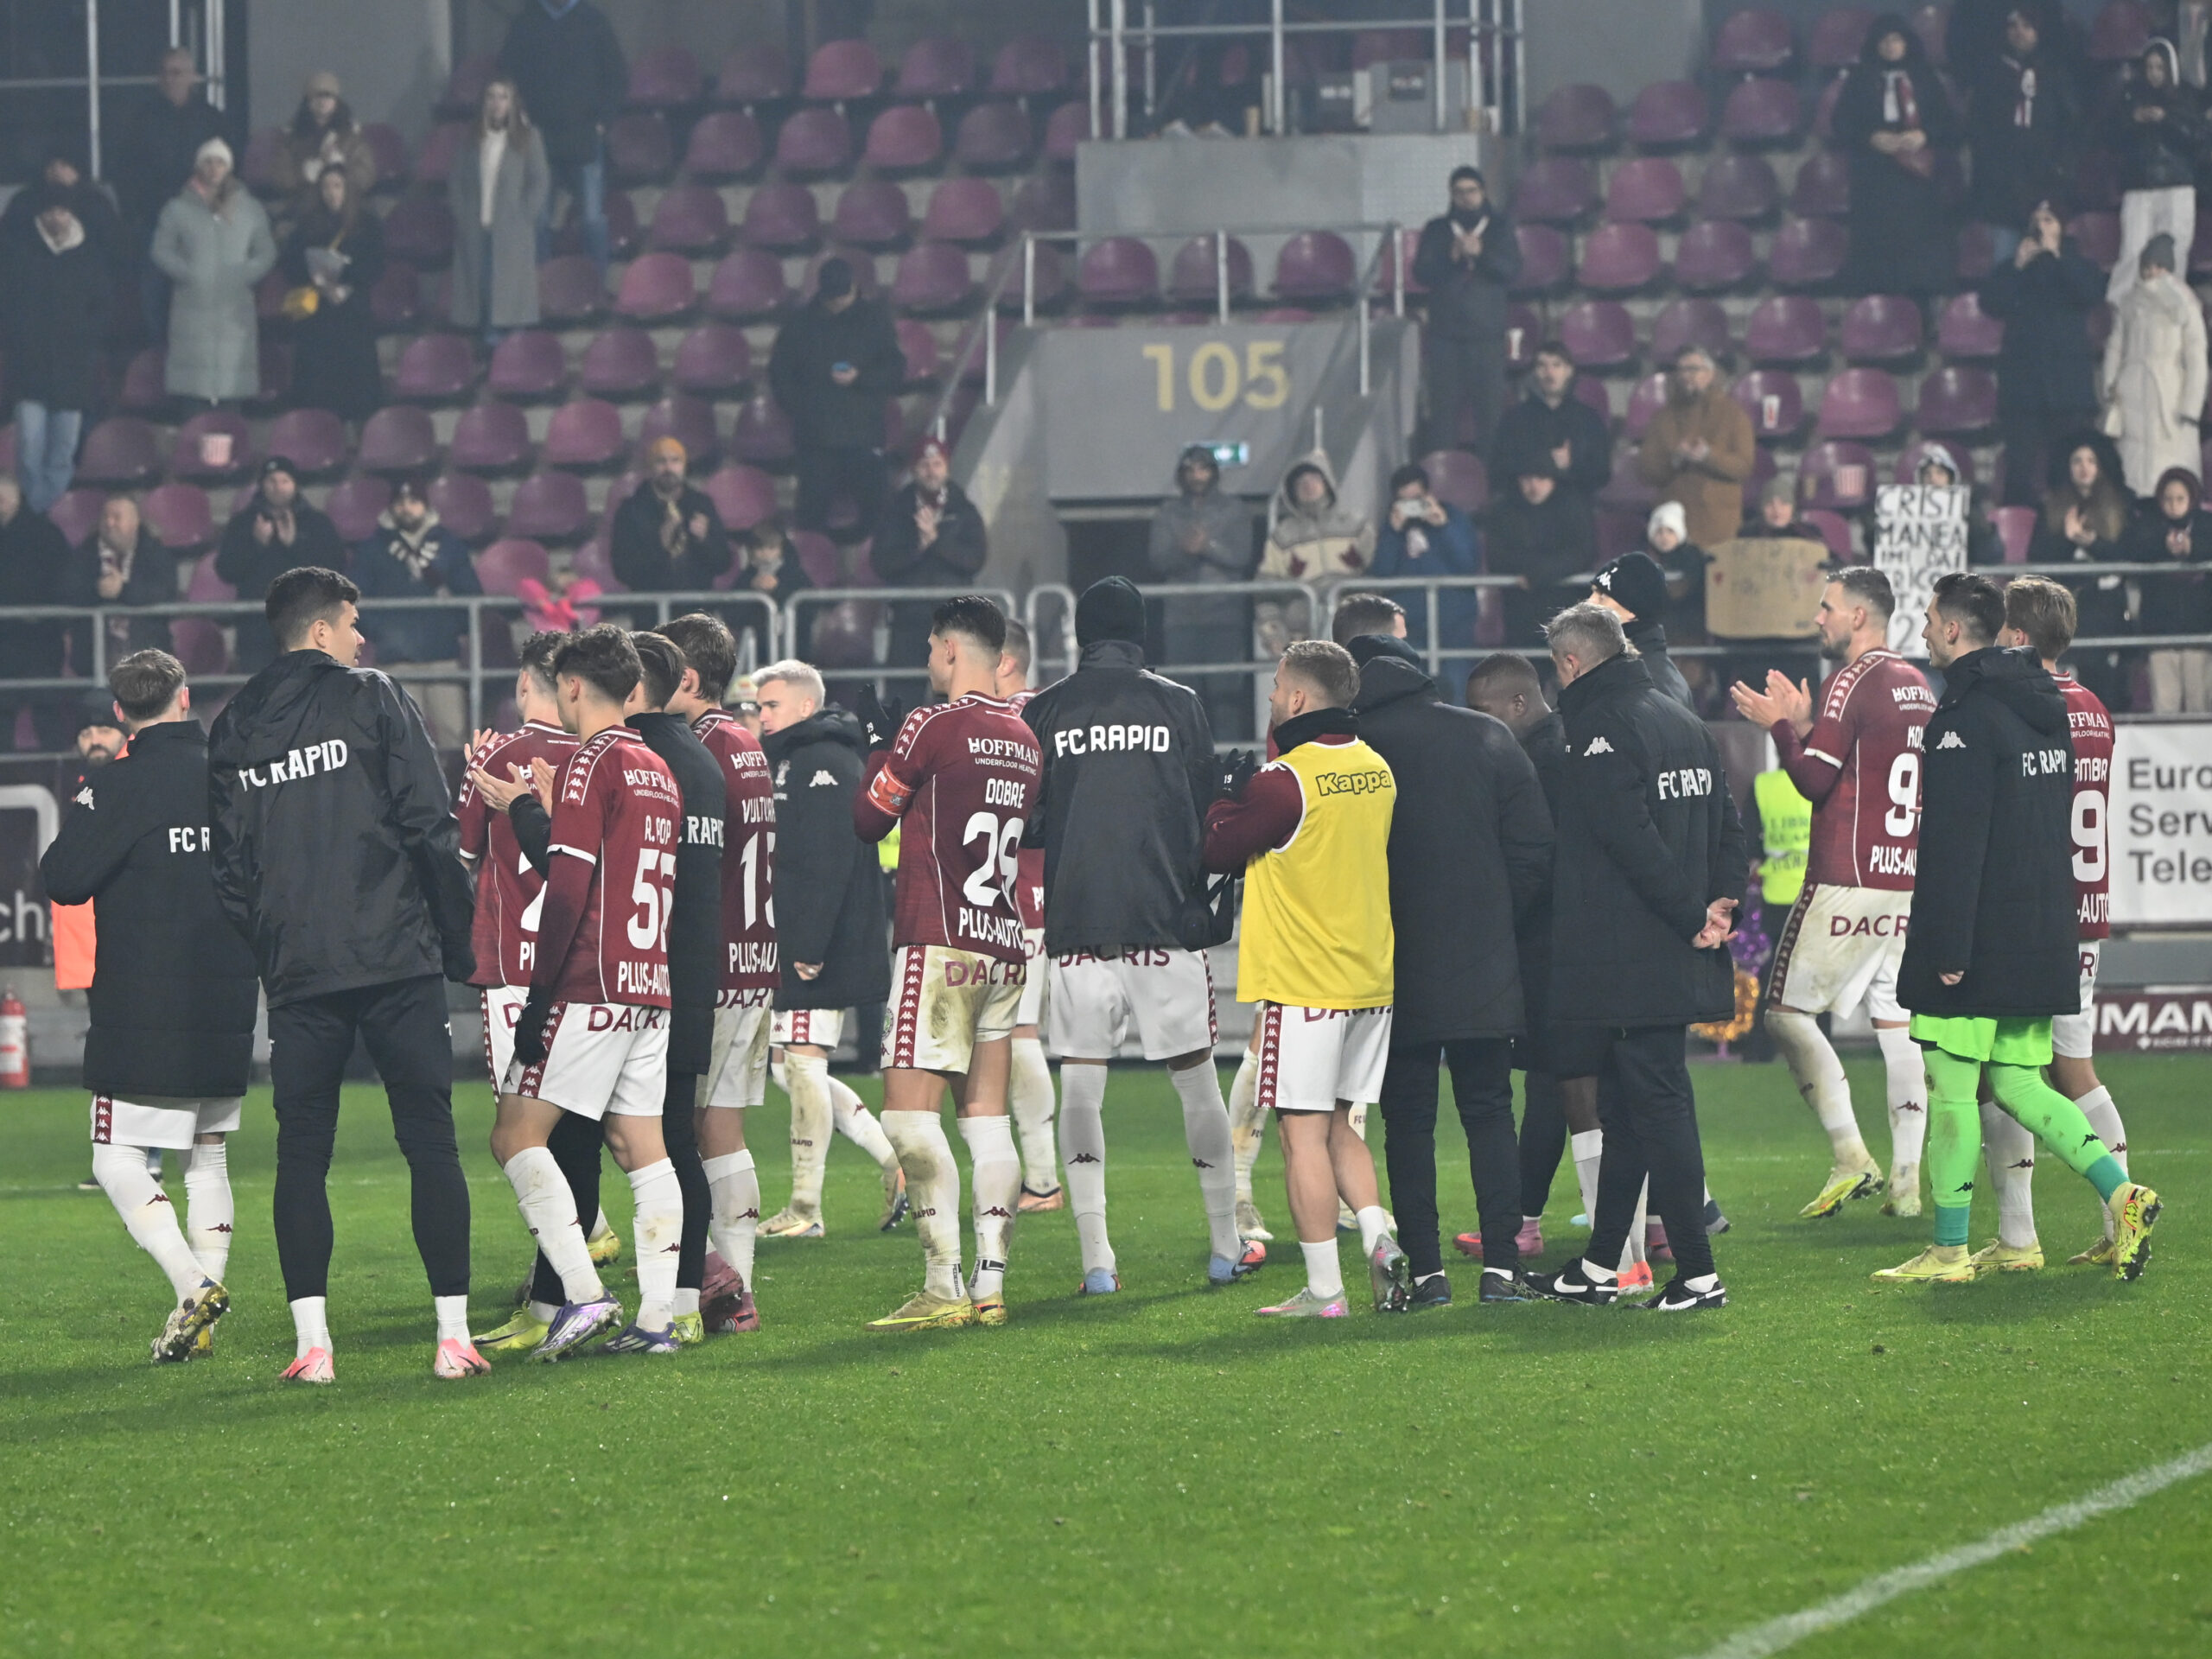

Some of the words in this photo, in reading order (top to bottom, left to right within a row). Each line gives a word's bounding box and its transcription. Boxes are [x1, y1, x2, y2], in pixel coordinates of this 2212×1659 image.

[1142, 340, 1290, 412] 105
[1875, 484, 1970, 518] CRISTI
[1876, 522, 1967, 549] MANEA
[968, 737, 1039, 766] HOFFMAN
[1054, 728, 1086, 759] FC
[1090, 724, 1170, 753] RAPID
[975, 757, 1018, 770] UNDERFLOOR
[2022, 751, 2037, 778] FC
[985, 778, 1026, 810] DOBRE
[1316, 770, 1392, 797] Kappa
[1658, 771, 1680, 801] FC
[168, 827, 196, 854] FC
[2127, 849, 2212, 883] Tele
